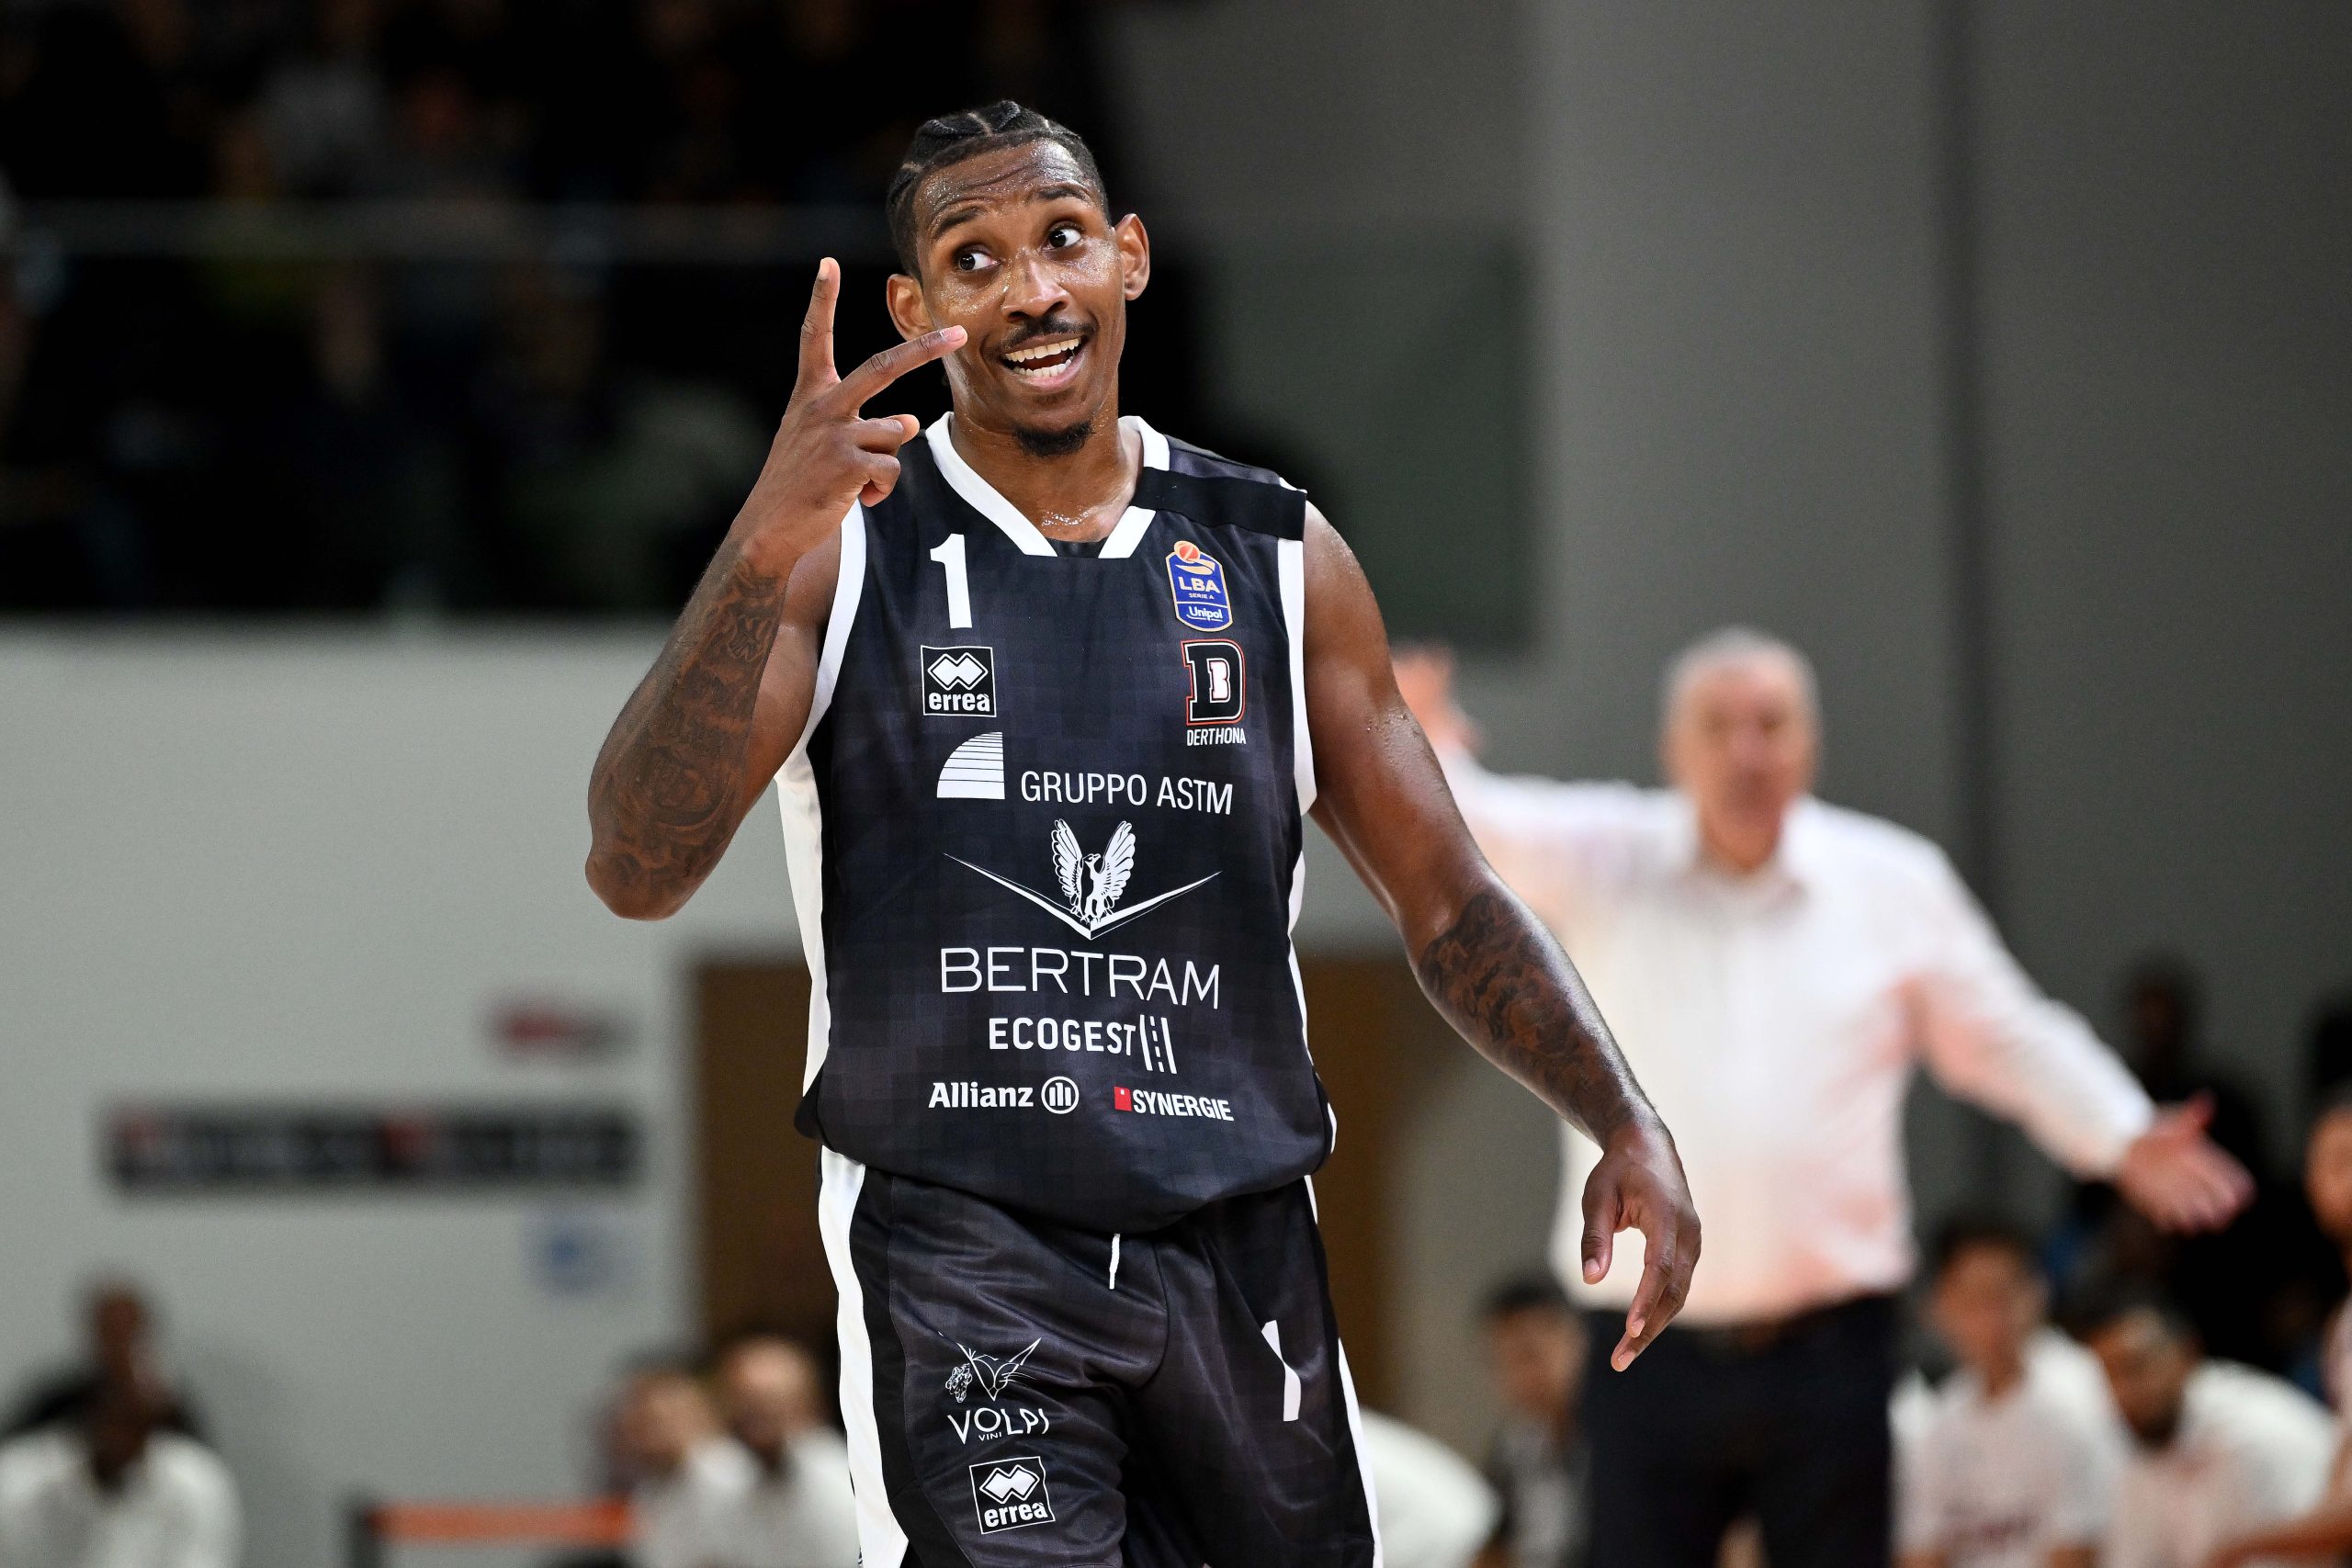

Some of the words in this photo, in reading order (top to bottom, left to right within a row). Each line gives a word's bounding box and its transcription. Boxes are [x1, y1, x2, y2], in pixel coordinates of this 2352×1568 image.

[930, 533, 973, 629] 1
[1178, 576, 1221, 593] LBA
[1188, 605, 1224, 622] Unipol
[1186, 727, 1247, 747] DERTHONA
[1021, 771, 1148, 806] GRUPPO
[1157, 776, 1233, 816] ASTM
[940, 946, 1221, 1010] BERTRAM
[989, 1017, 1136, 1056] ECOGEST
[928, 1082, 1035, 1109] Allianz
[1132, 1089, 1235, 1122] SYNERGIE
[947, 1407, 1049, 1445] VOLPI
[978, 1431, 1002, 1442] VINI
